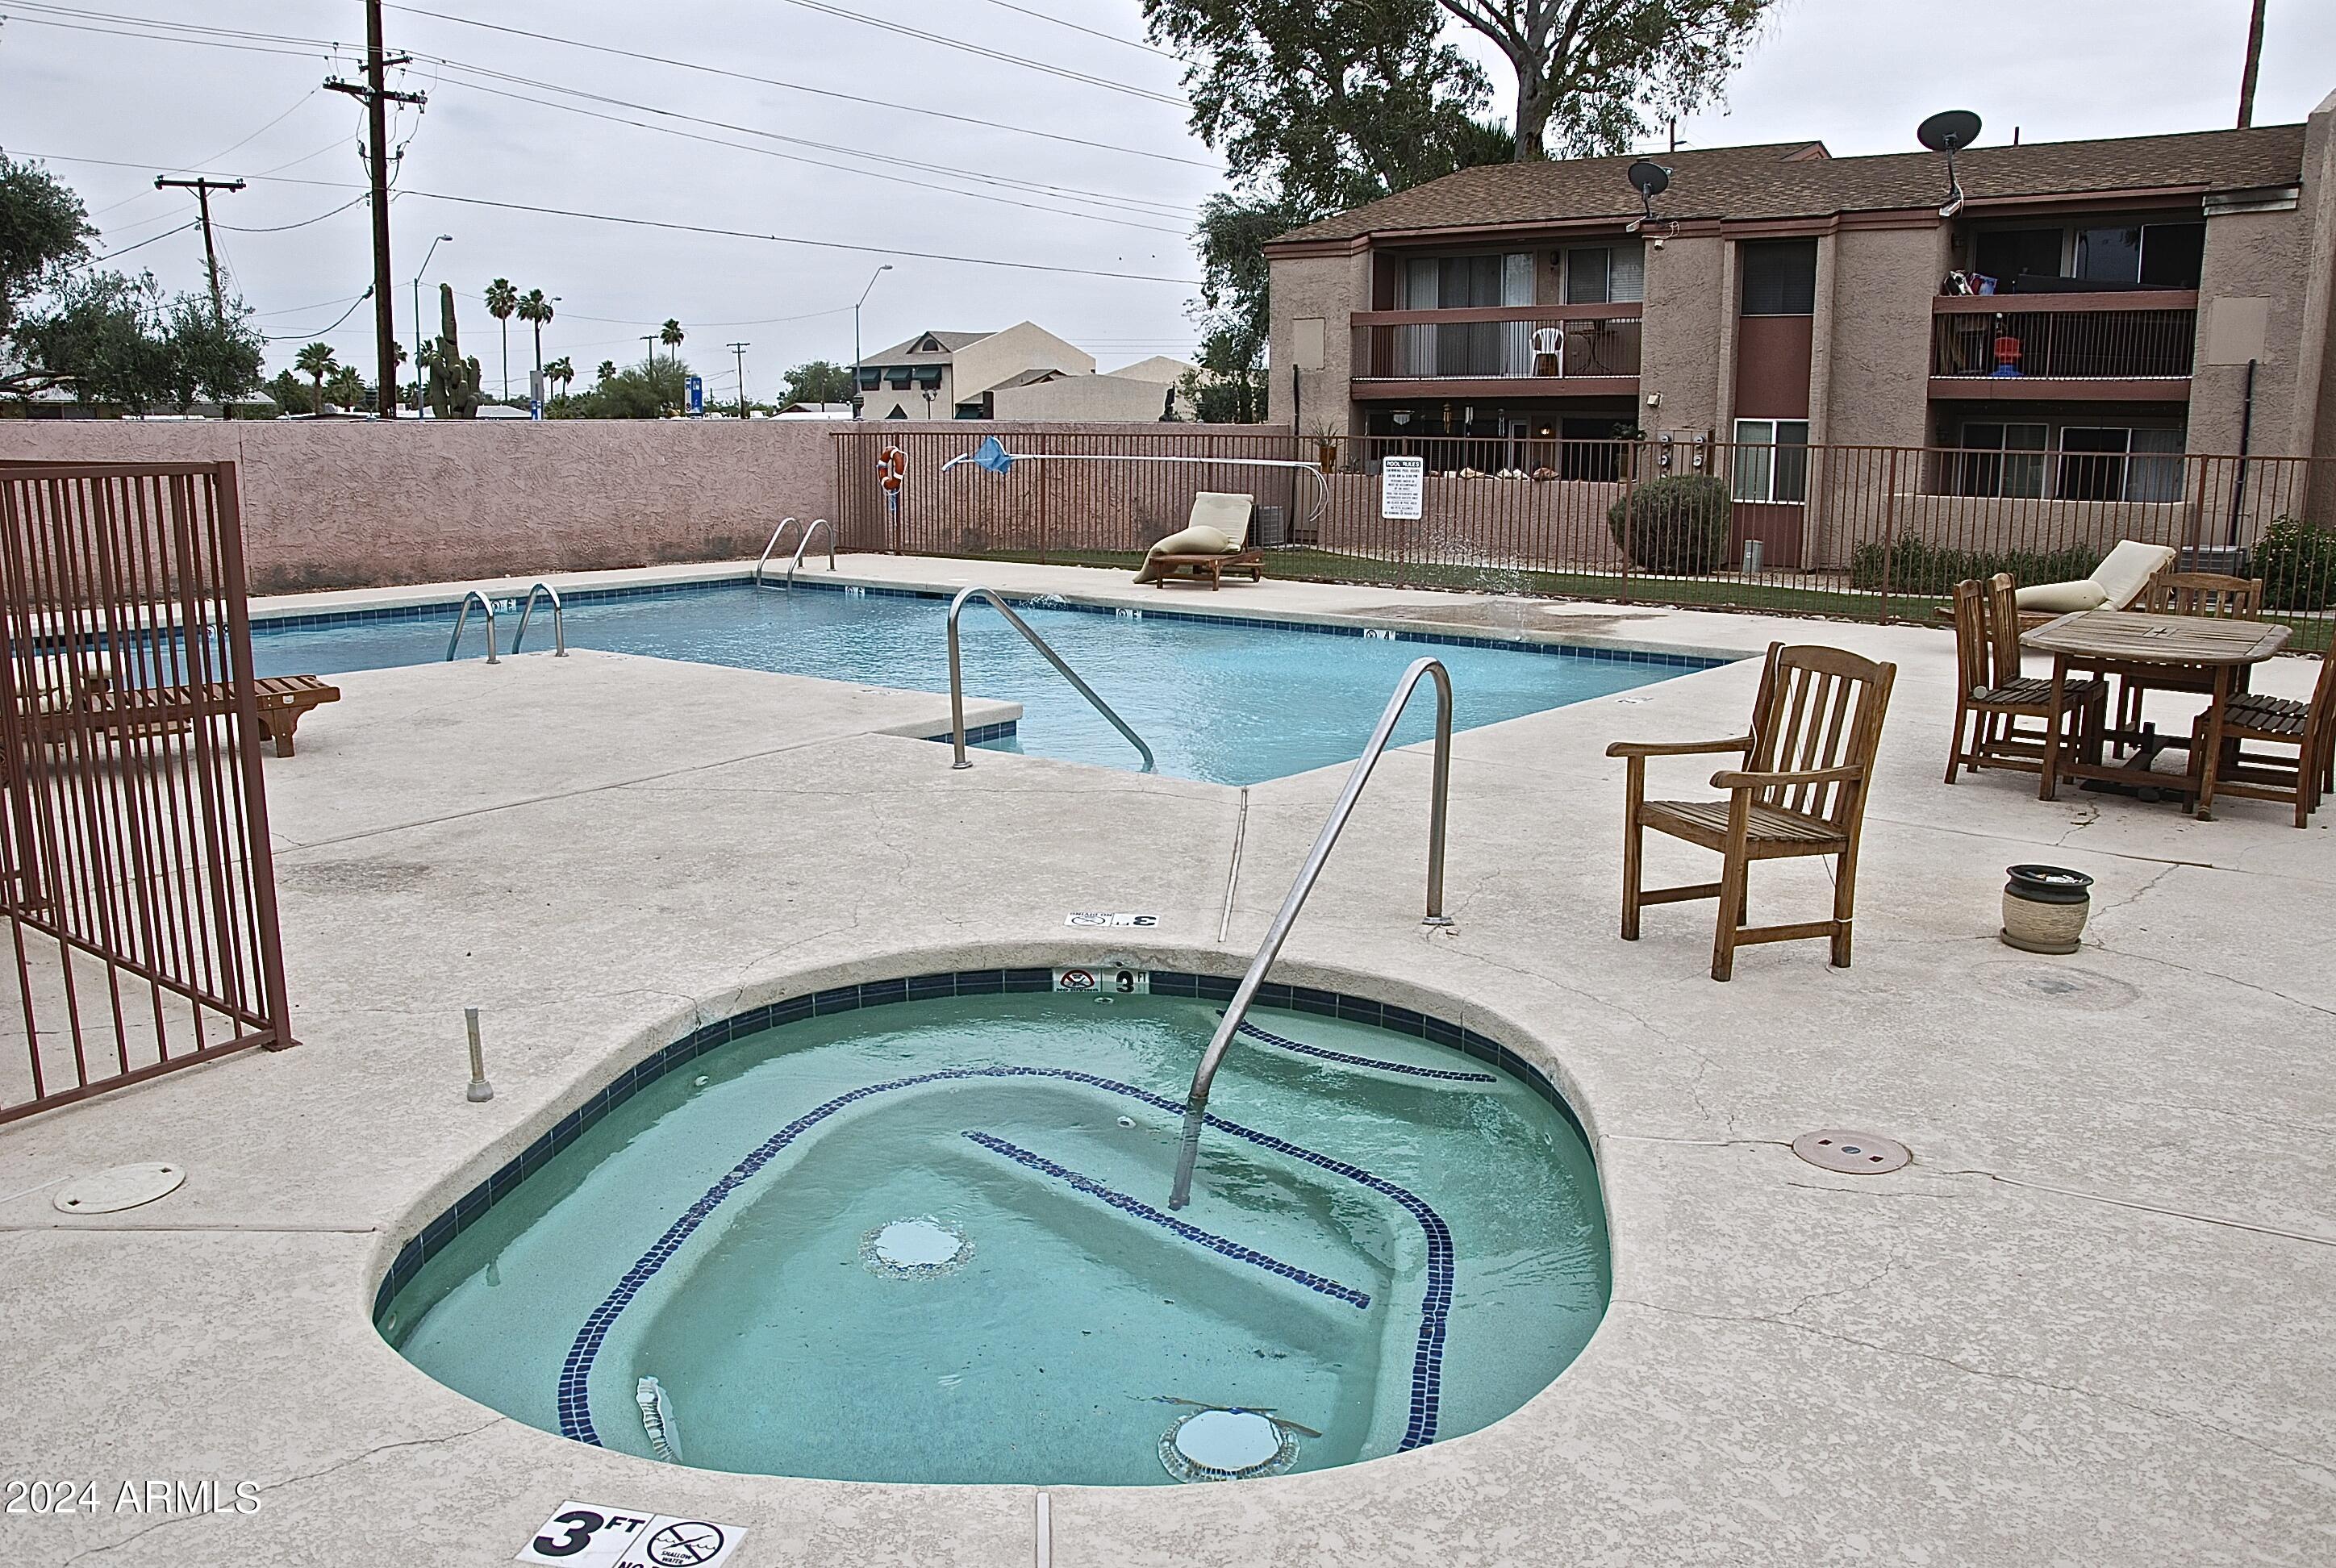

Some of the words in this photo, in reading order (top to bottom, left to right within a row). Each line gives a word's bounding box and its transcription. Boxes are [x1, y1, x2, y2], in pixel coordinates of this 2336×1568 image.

[1133, 915, 1157, 926] 3
[1116, 970, 1134, 993] 3
[1137, 972, 1146, 982] FT
[532, 1510, 604, 1557] 3
[604, 1516, 646, 1533] FT
[661, 1550, 693, 1560] SHALLOW
